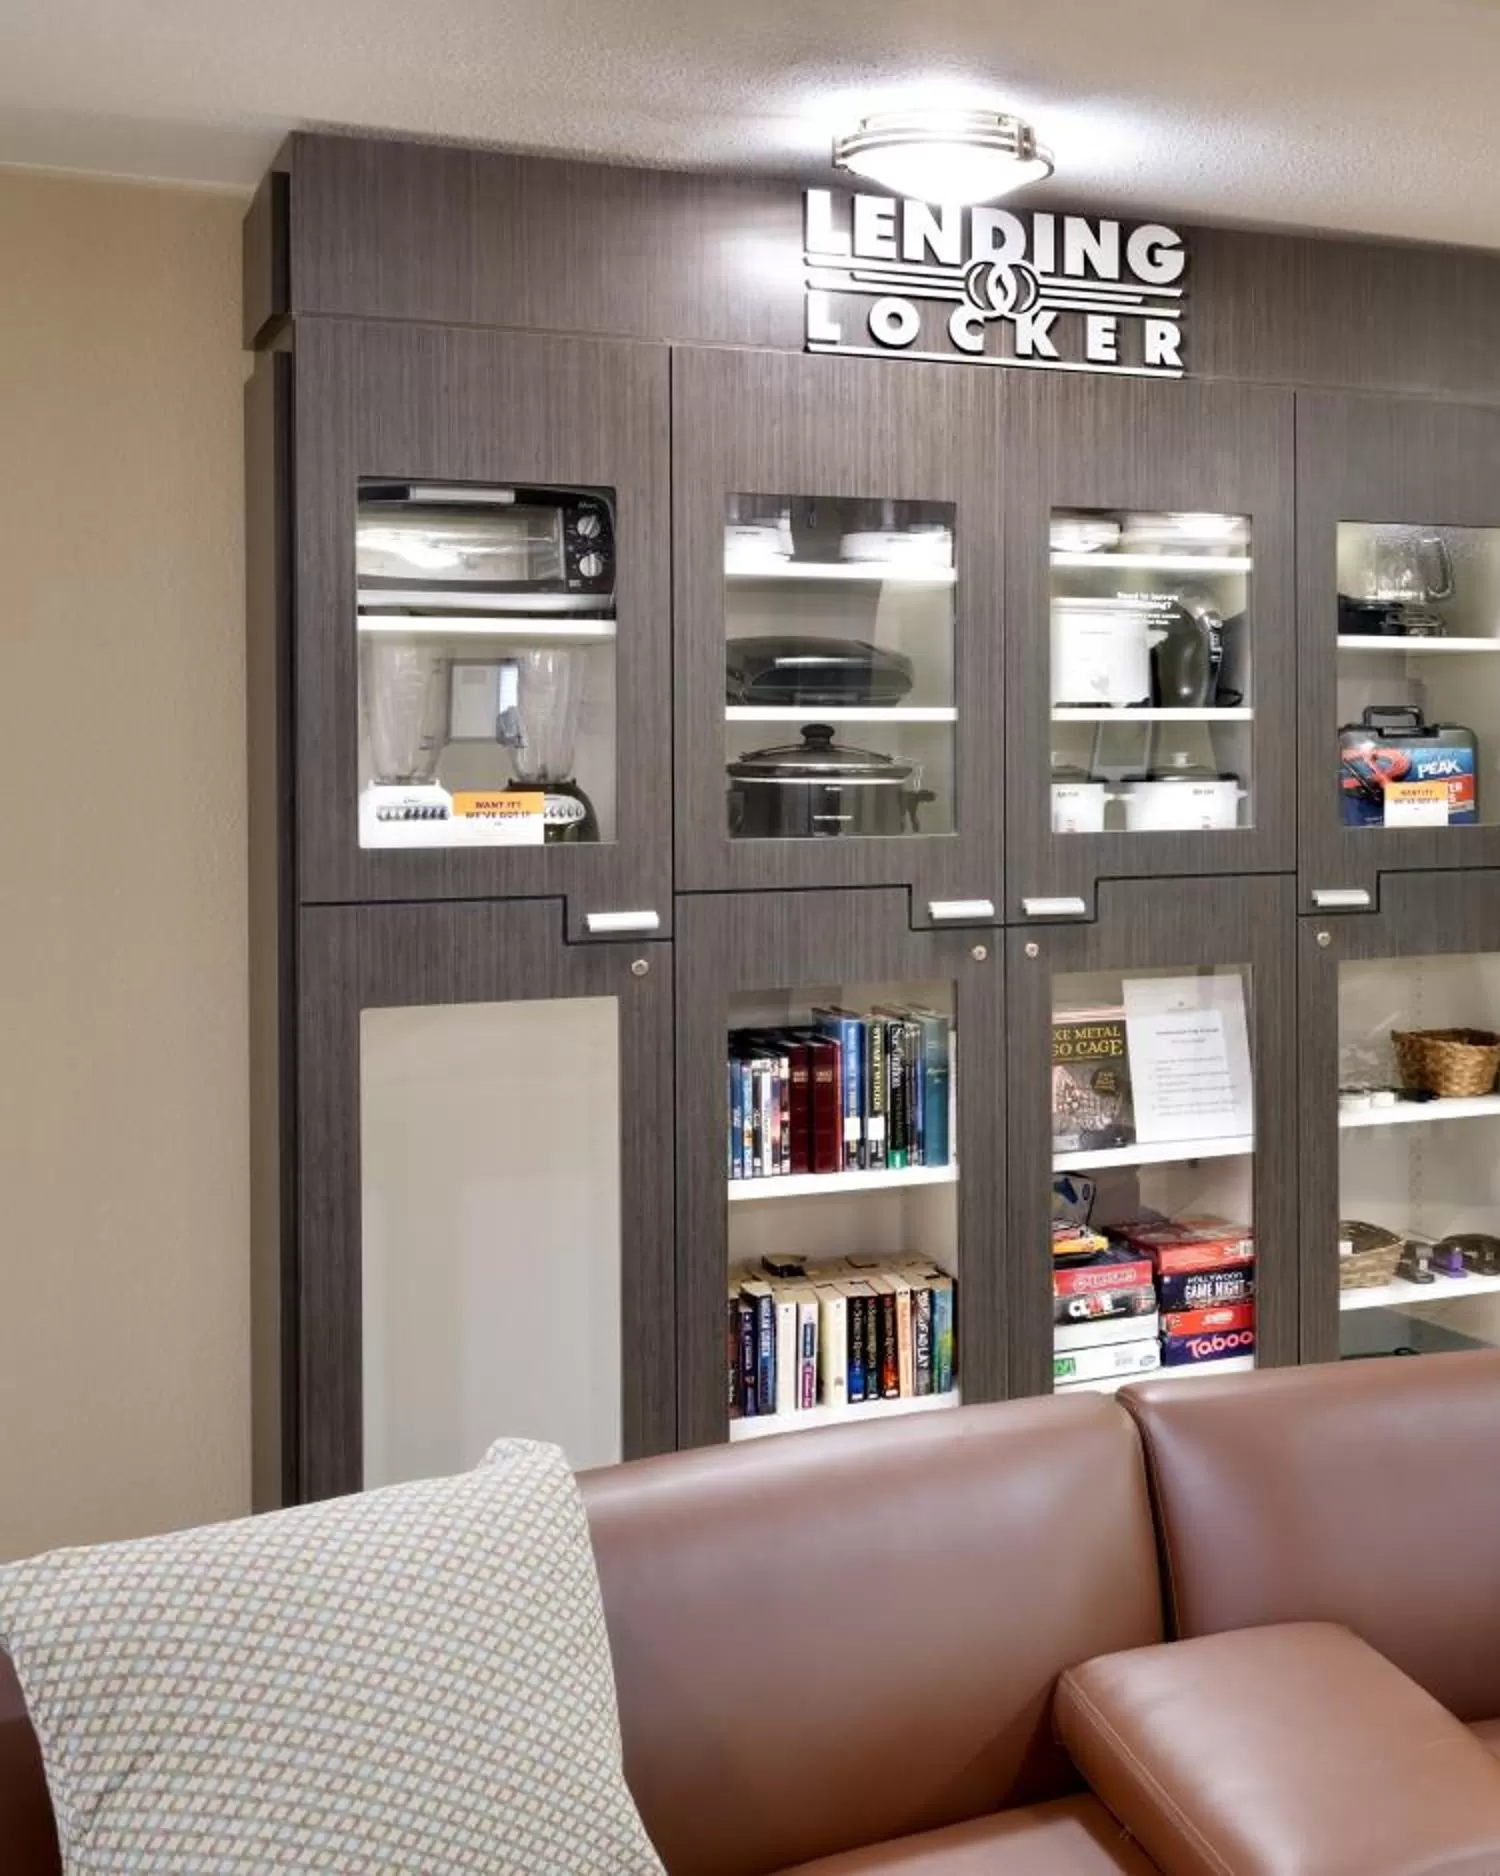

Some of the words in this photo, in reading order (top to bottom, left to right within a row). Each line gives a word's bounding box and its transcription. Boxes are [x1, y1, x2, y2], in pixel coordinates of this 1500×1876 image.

[805, 188, 1185, 284] LENDING
[806, 288, 1184, 367] LOCKER
[1417, 760, 1463, 778] PEAK
[1074, 1025, 1121, 1039] METAL
[1075, 1039, 1124, 1057] CAGE
[1187, 1272, 1243, 1285] HOLLYWOOD
[1184, 1283, 1213, 1301] GAME
[1215, 1279, 1245, 1298] NIGHT
[1186, 1331, 1253, 1358] Taboo
